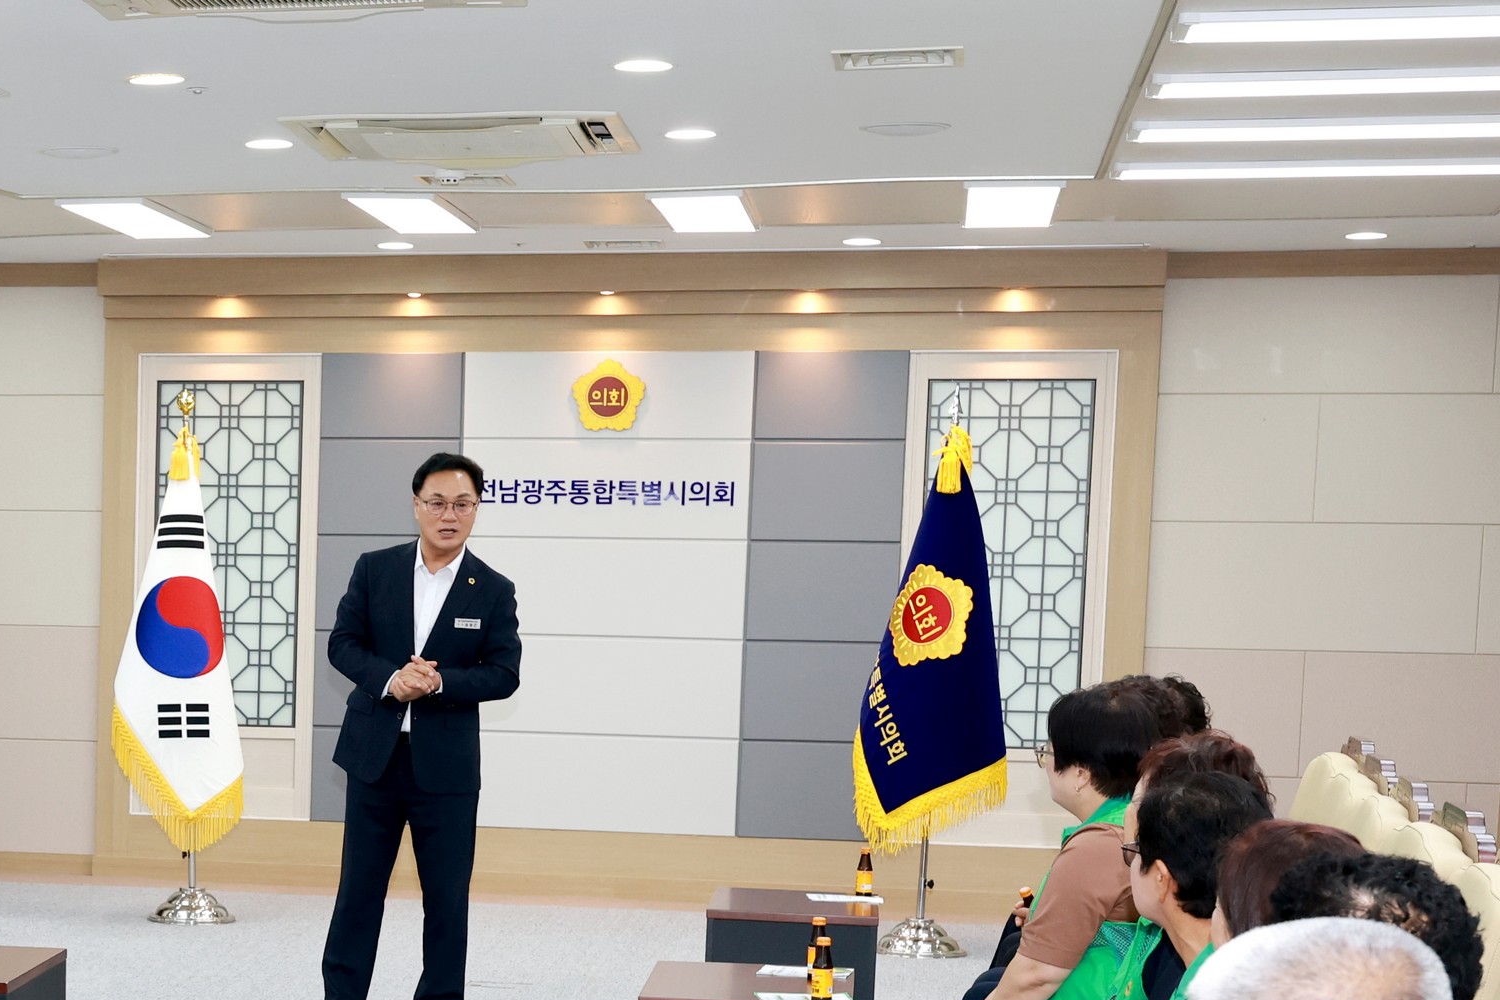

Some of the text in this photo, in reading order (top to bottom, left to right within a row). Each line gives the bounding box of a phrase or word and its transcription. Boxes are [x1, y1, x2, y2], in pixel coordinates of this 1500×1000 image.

[590, 387, 625, 407] 의회
[480, 479, 735, 507] 전남광주통합특별시의회
[908, 594, 943, 641] 의회
